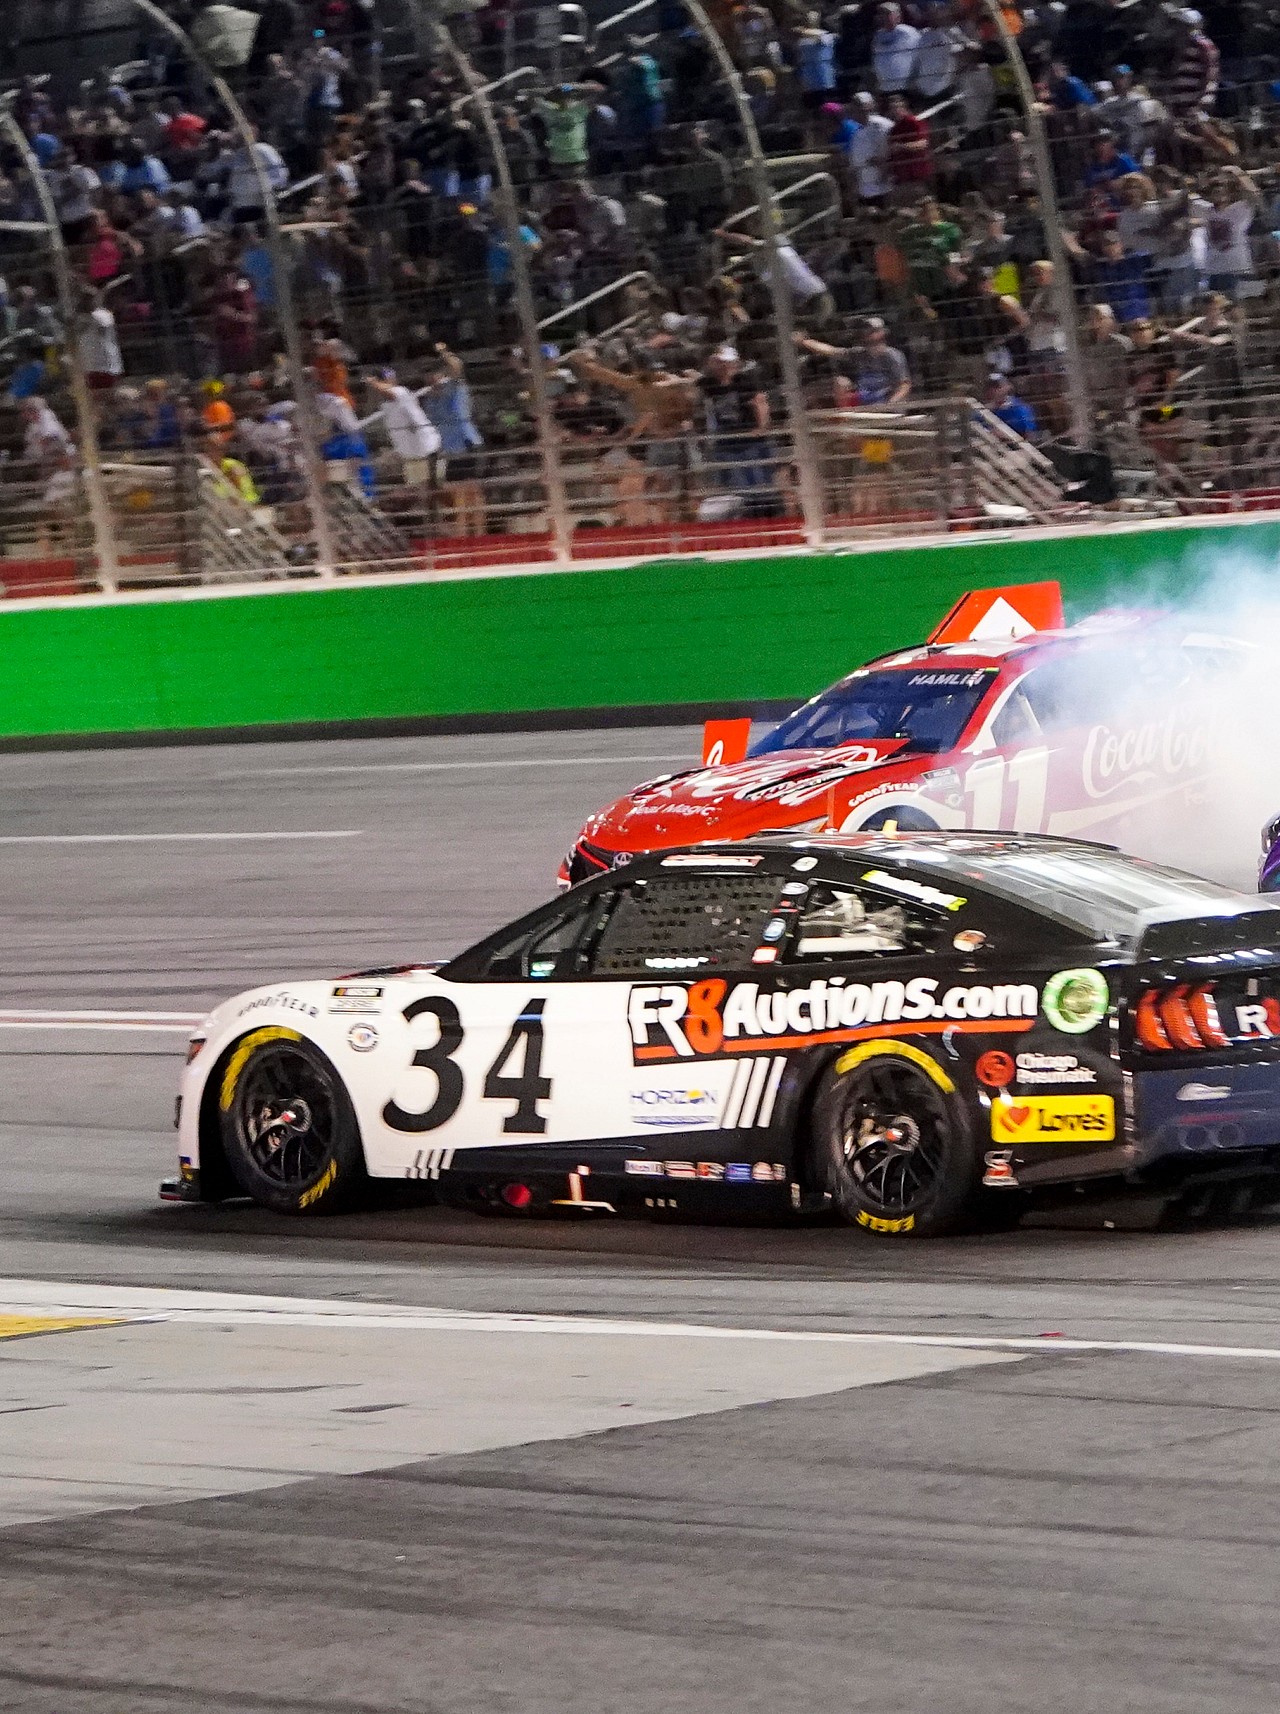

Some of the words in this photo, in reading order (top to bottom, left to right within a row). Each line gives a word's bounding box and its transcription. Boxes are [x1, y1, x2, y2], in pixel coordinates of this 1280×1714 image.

[847, 781, 919, 807] GOODYEAR
[965, 746, 1049, 832] 11
[382, 996, 555, 1135] 34
